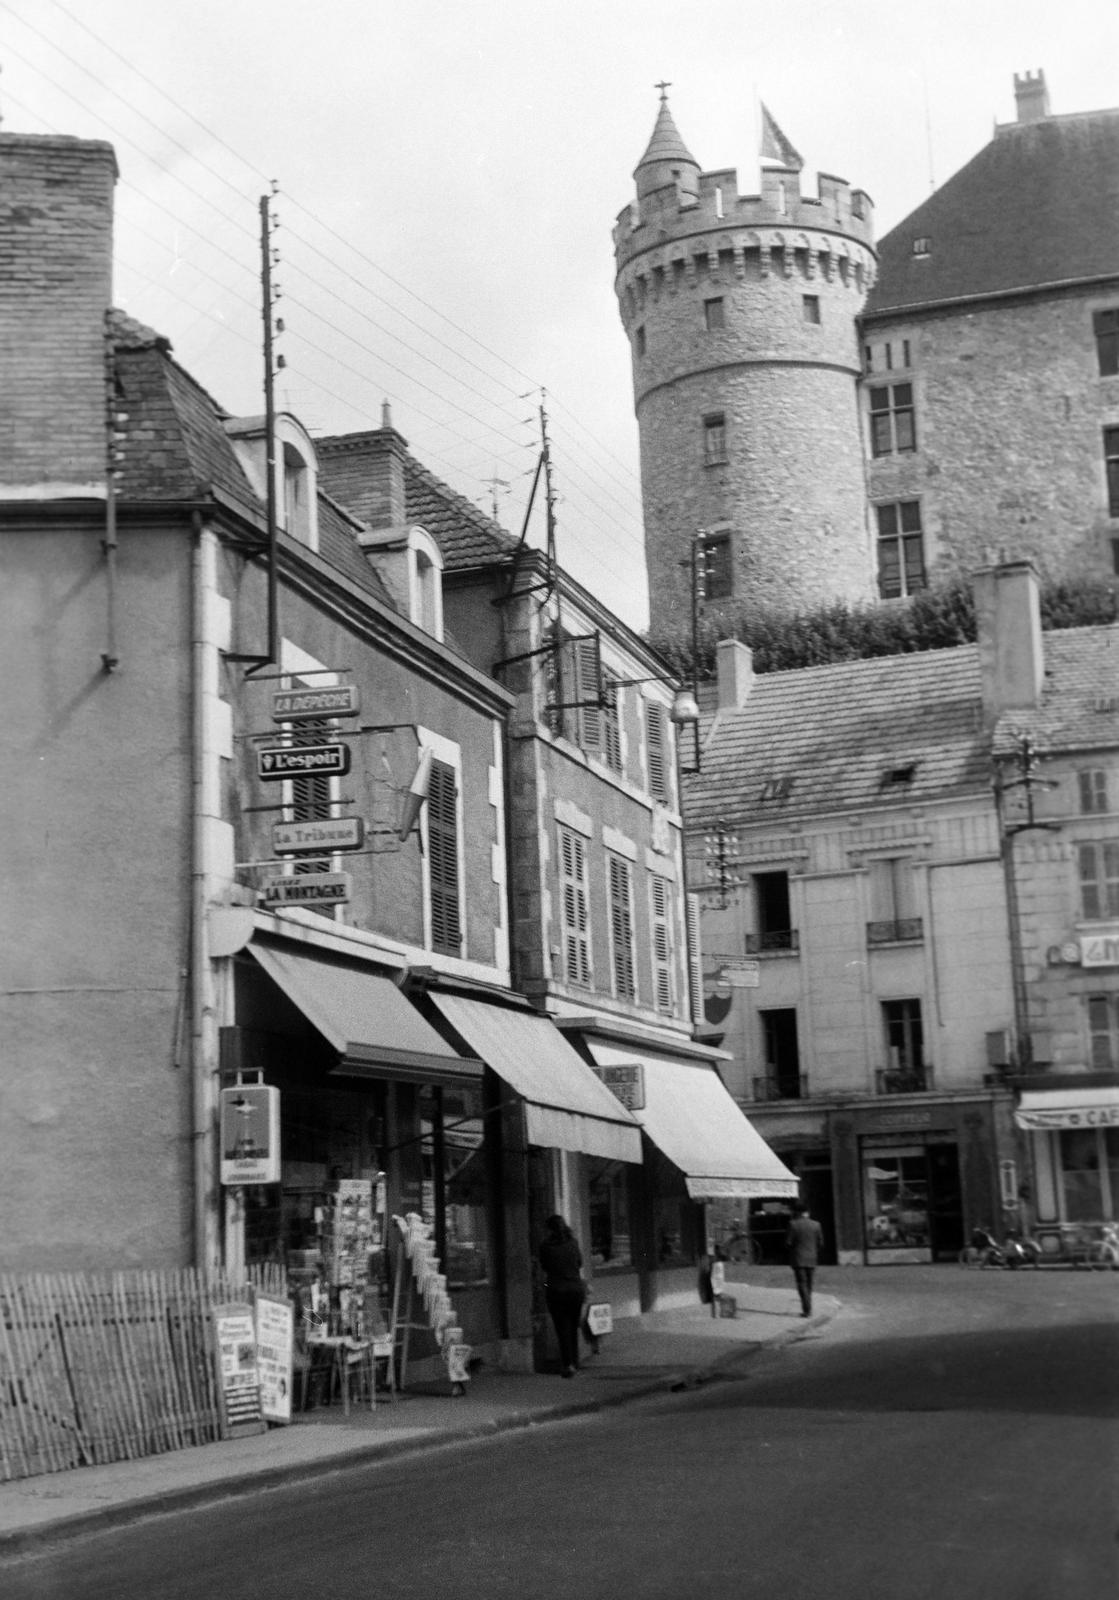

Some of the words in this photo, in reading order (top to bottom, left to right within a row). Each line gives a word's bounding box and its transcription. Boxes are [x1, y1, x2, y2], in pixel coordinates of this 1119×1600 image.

[275, 750, 340, 769] L'espoir
[274, 831, 291, 843] La
[294, 827, 354, 843] Tribune
[265, 887, 282, 901] LA
[285, 883, 347, 900] MONTAGNE
